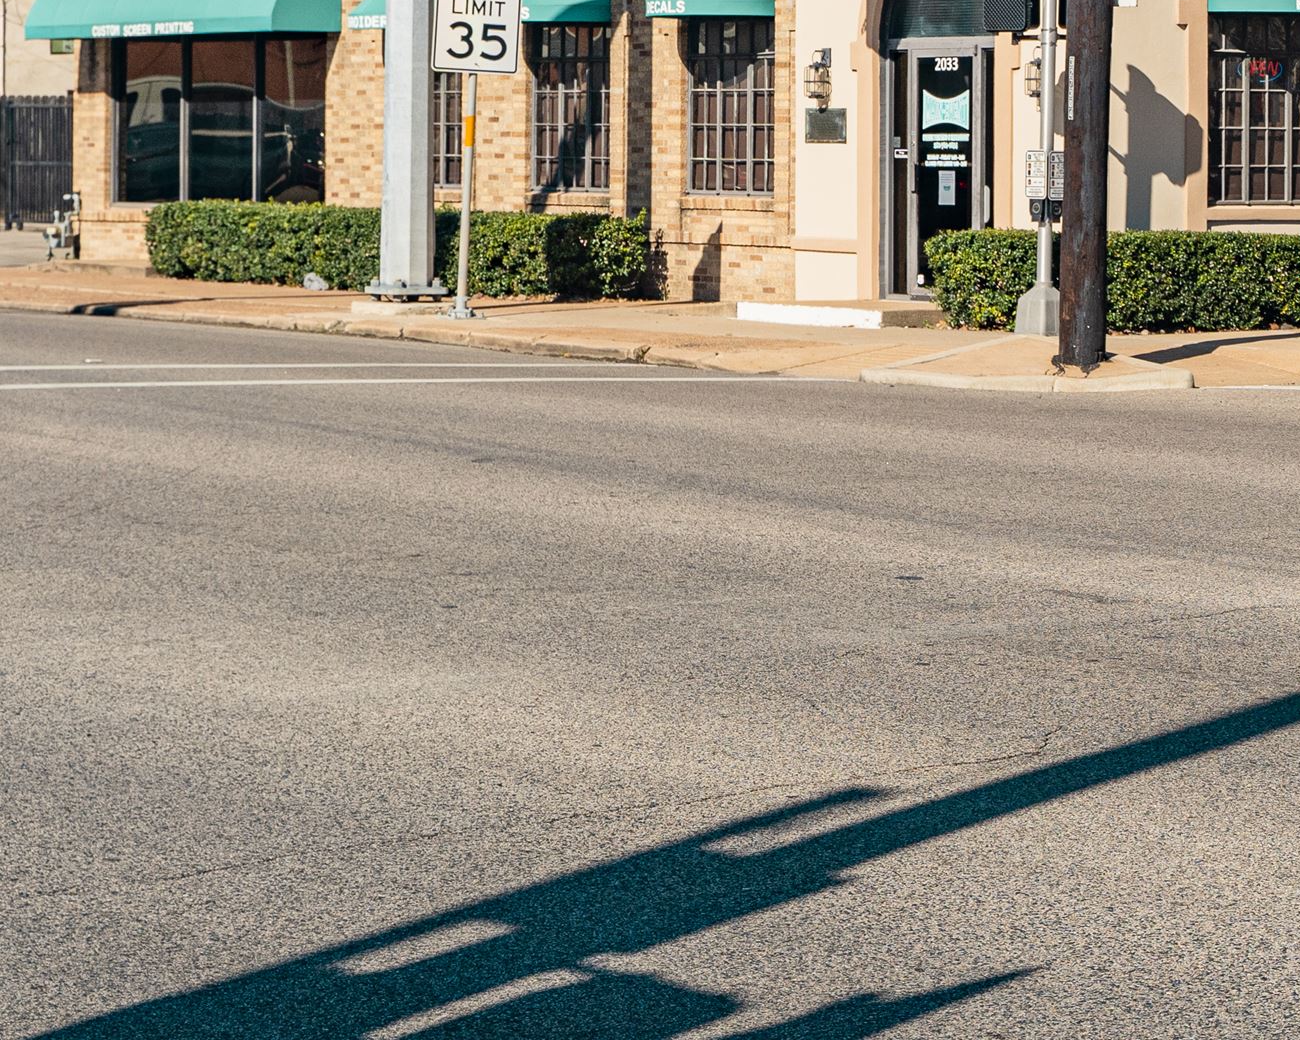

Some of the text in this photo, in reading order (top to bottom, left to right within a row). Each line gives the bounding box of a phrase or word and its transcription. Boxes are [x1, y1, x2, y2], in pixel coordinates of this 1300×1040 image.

[646, 0, 686, 14] DECALS
[91, 21, 195, 38] CUSTOM SCREEN PRINTING
[446, 21, 508, 62] 35
[934, 57, 959, 72] 2033
